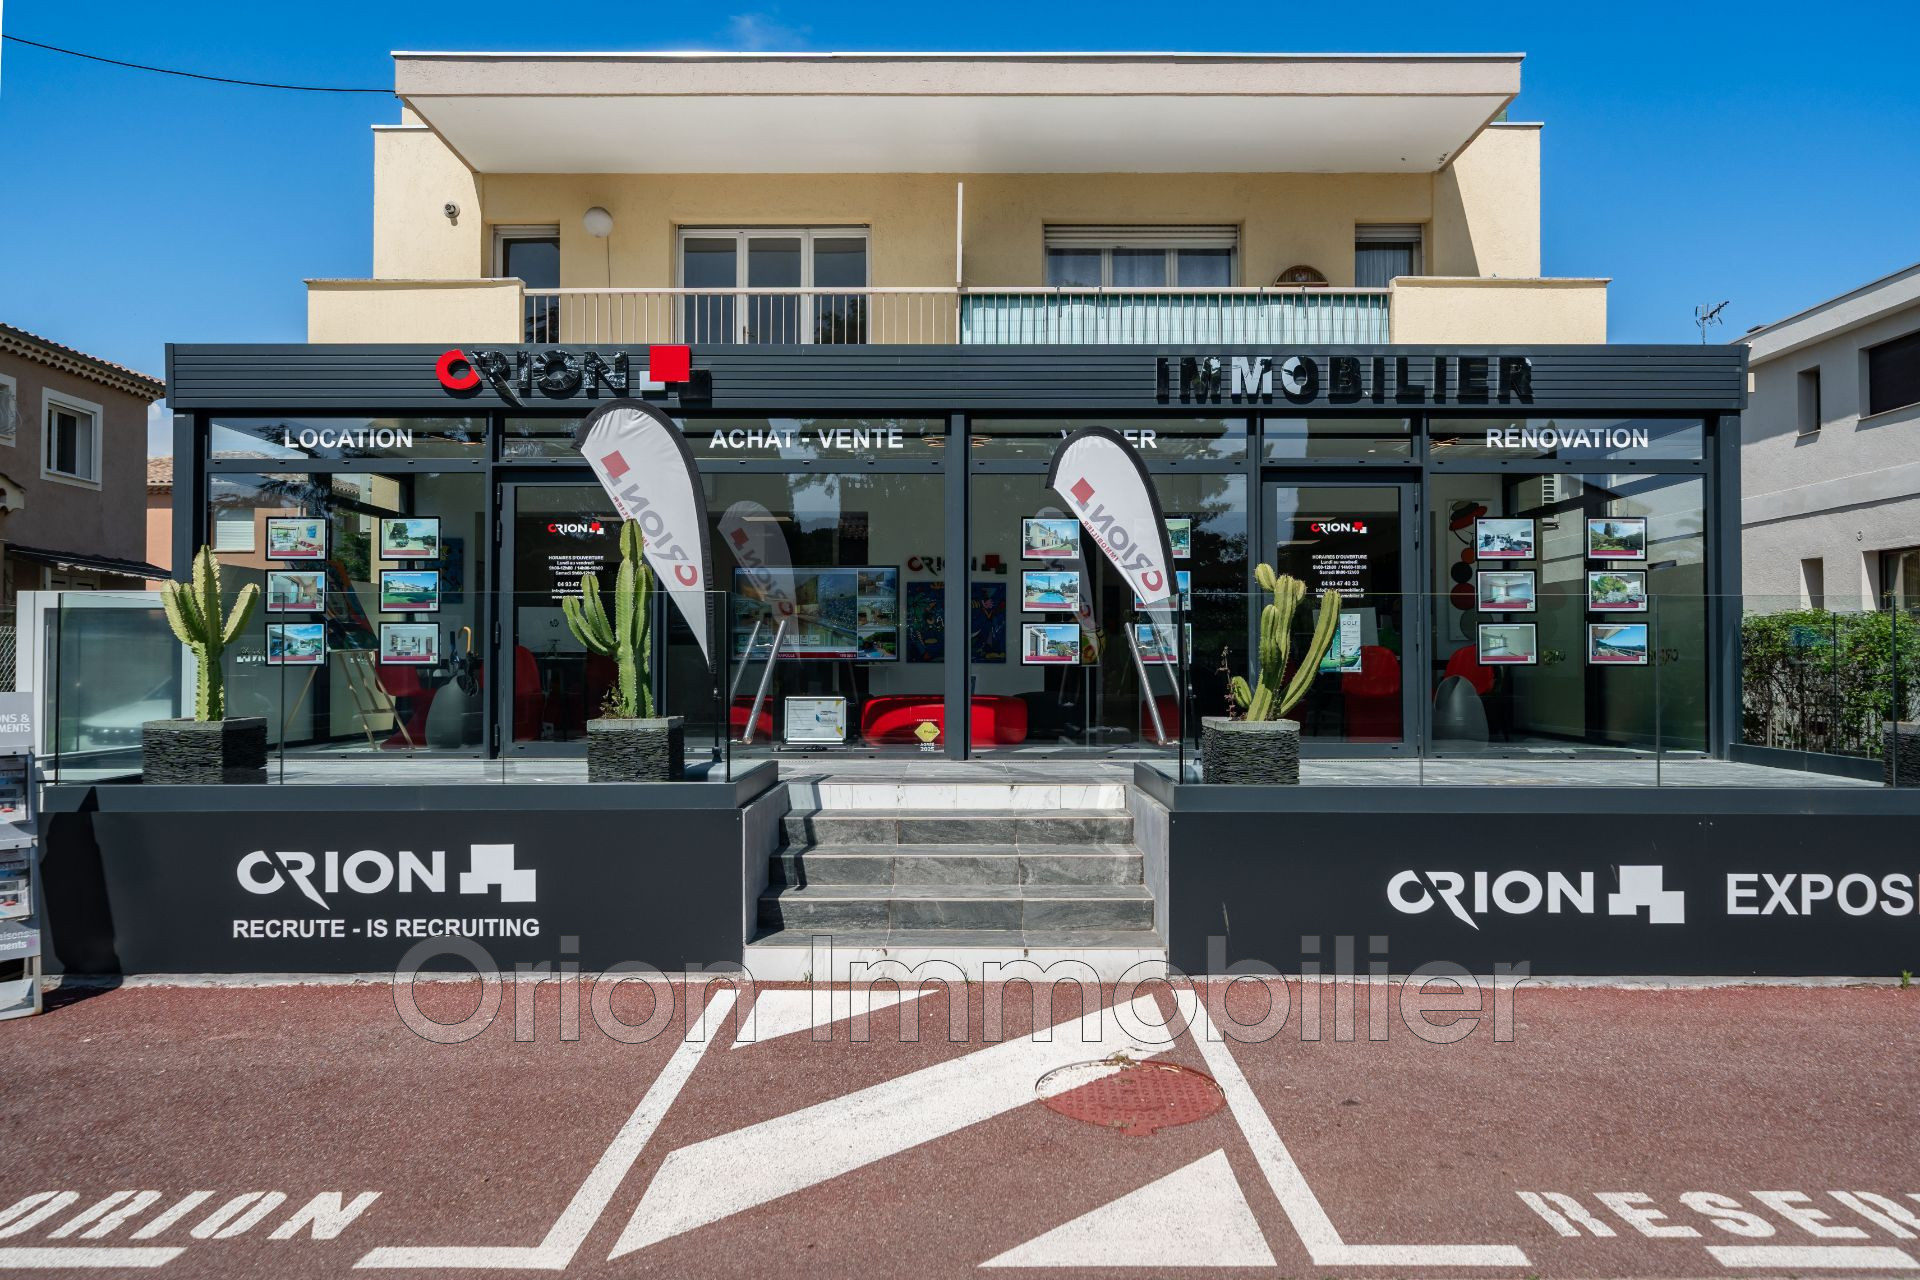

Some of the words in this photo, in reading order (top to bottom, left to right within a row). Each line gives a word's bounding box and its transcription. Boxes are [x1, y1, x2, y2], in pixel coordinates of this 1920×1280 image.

[436, 349, 630, 407] ORION
[1156, 355, 1534, 402] IMMOBILIER
[284, 429, 413, 448] LOCATION
[709, 429, 796, 448] ACHAT
[817, 429, 904, 448] VENTE
[1486, 423, 1649, 448] RÉNOVATION
[547, 523, 588, 536] ORION
[1311, 522, 1351, 535] ORION
[236, 850, 446, 910] ORION
[1386, 870, 1594, 931] ORION
[1726, 873, 1920, 917] EXPOS
[232, 919, 346, 939] RECRUTE
[366, 919, 388, 938] IS
[395, 918, 541, 938] RECRUITING
[1515, 1190, 1920, 1238] RESER
